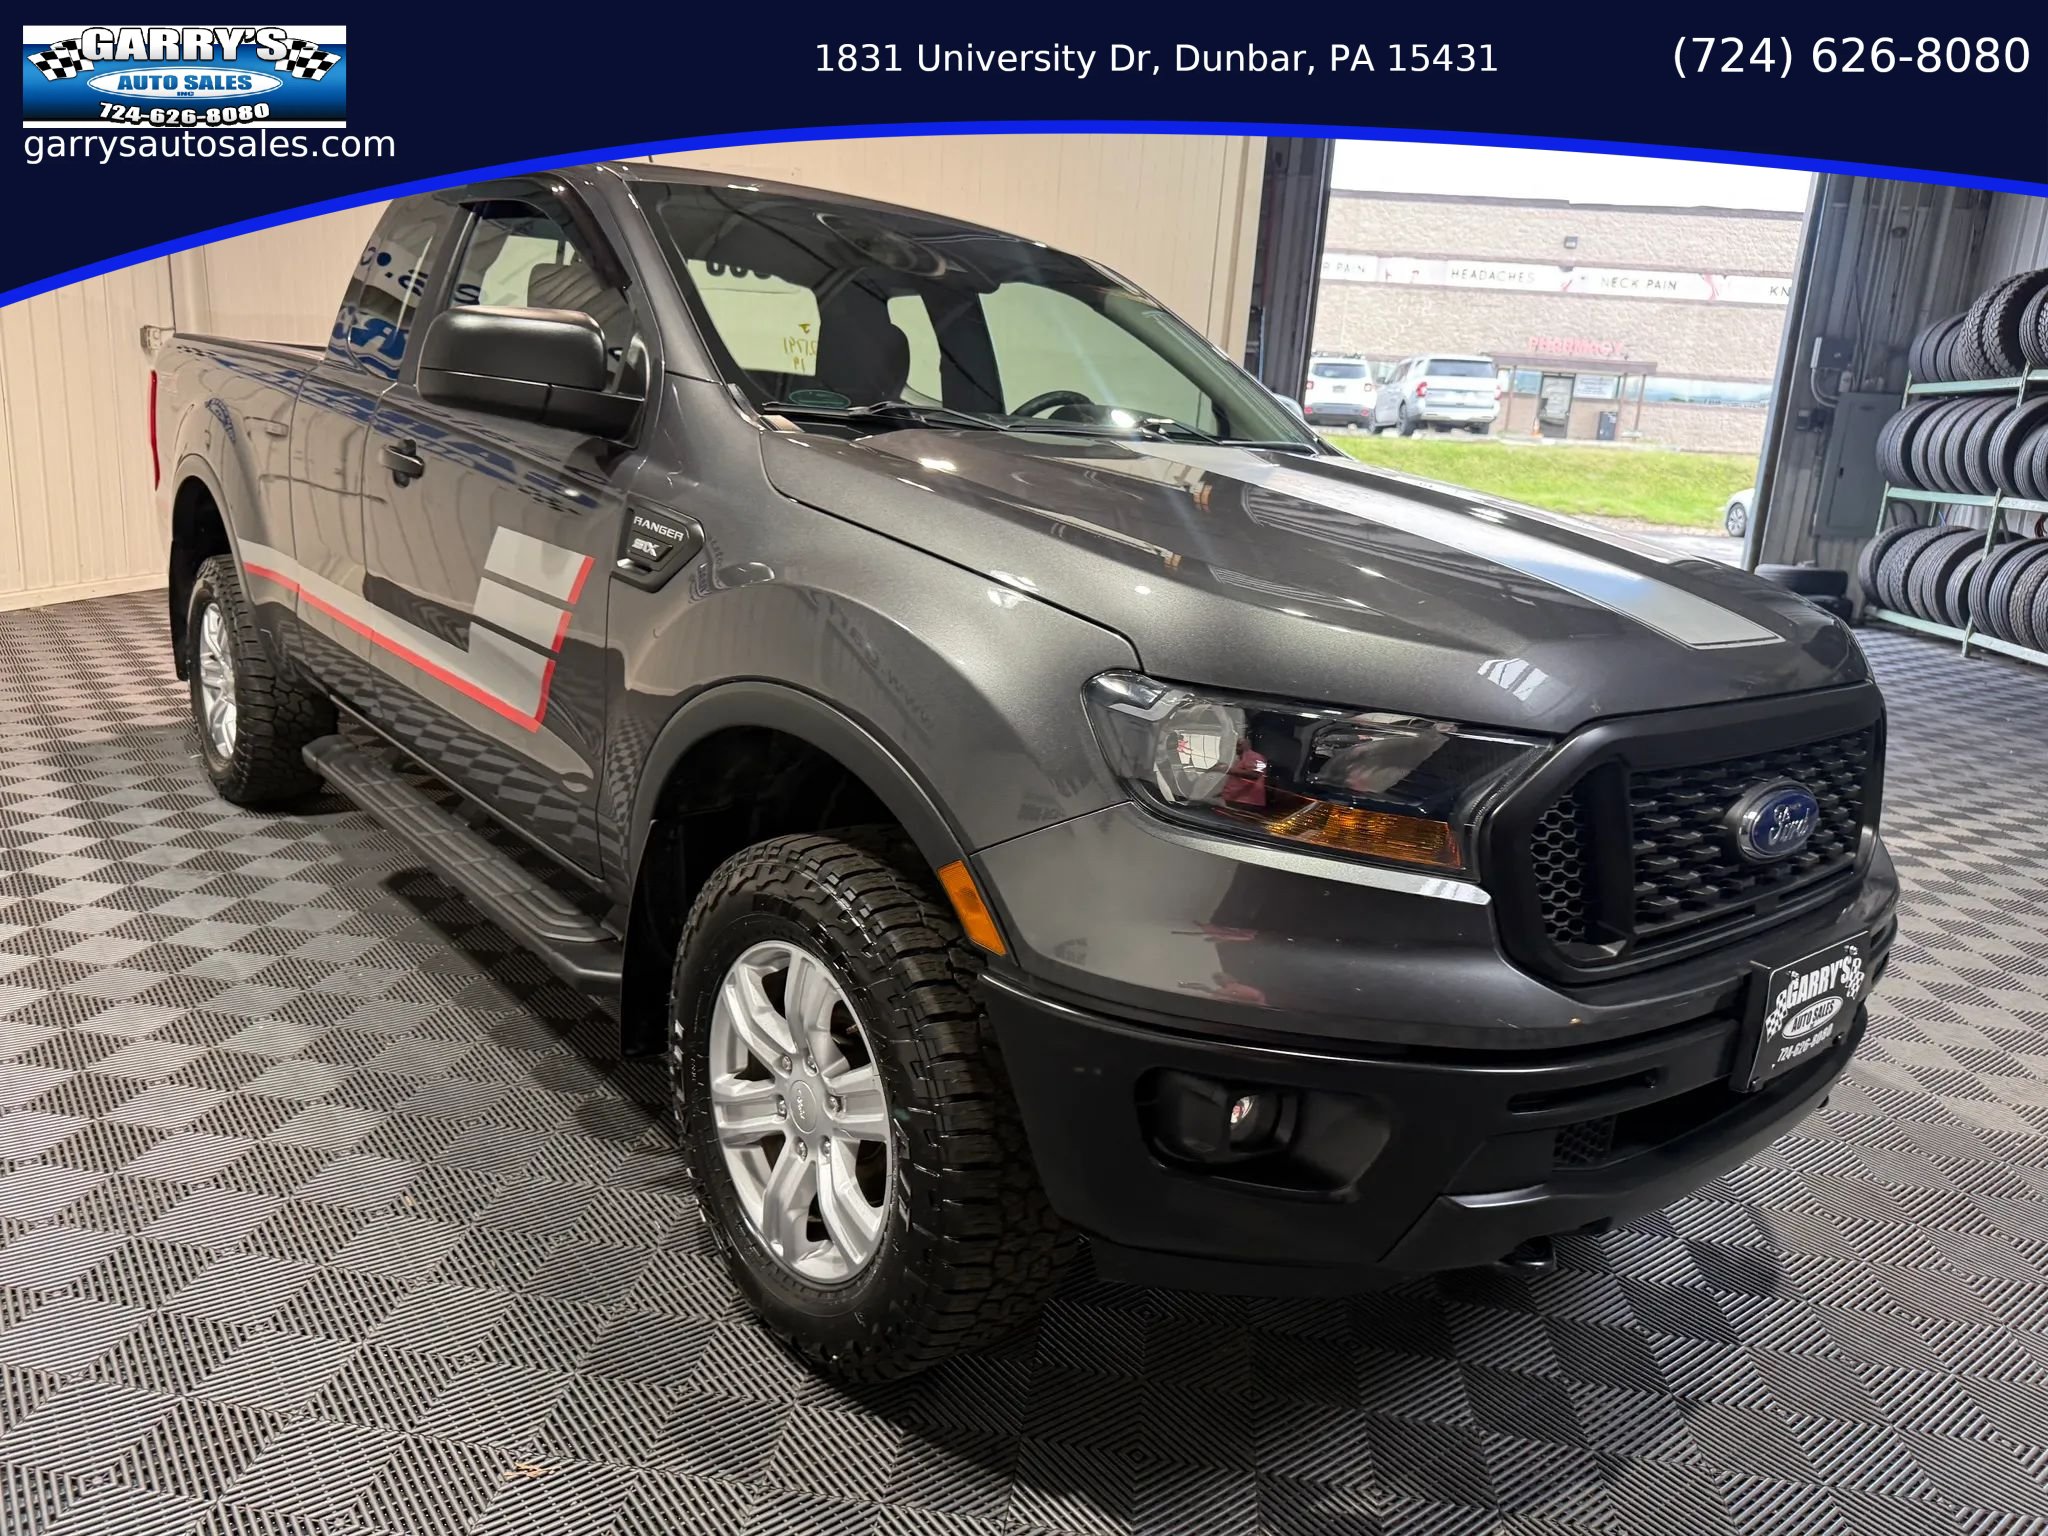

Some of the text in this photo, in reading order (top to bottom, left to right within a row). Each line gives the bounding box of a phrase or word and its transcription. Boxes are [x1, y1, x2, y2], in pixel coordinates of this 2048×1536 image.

[1451, 270, 1536, 282] HEADACHES
[1601, 277, 1678, 290] NECK PAIN
[1529, 337, 1623, 355] PHARMACY
[633, 516, 684, 541] RANGER
[631, 538, 660, 556] STX
[1786, 956, 1853, 1009] GARRY'S
[1790, 999, 1835, 1033] AUTO SALES
